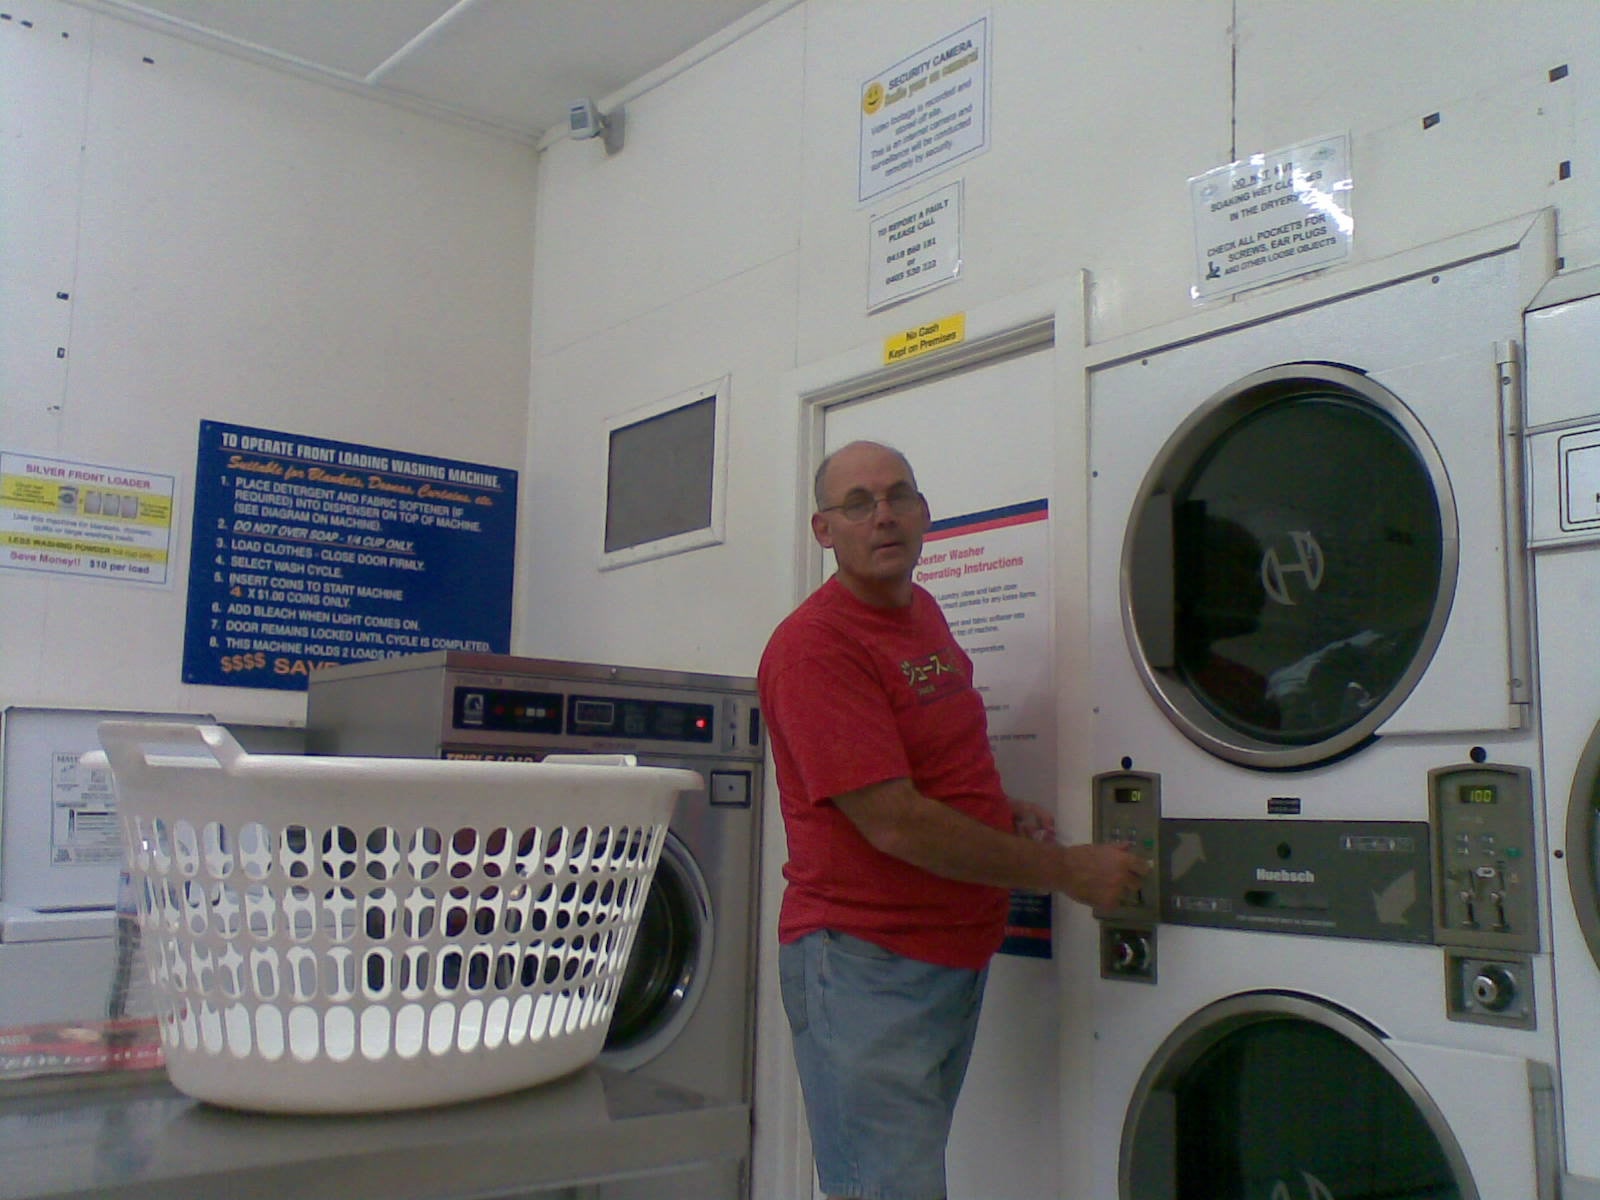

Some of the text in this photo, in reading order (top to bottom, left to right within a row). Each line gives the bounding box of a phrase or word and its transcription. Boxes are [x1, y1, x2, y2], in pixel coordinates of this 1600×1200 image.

[888, 59, 931, 90] SECURITY
[932, 39, 972, 66] CAMERA
[1210, 192, 1250, 212] SOAKING
[1253, 184, 1273, 199] WET
[888, 213, 917, 232] REPORT
[925, 199, 949, 216] FAULT
[1230, 212, 1239, 222] IN
[1241, 205, 1259, 218] THE
[889, 217, 936, 243] PLEASE CALL
[1207, 213, 1326, 258] CHECK ALL POCKETS FOR
[1270, 226, 1327, 249] EAR PLUGS
[1224, 237, 1337, 276] AND OTHER LOOSE OBJECTS
[906, 323, 939, 341] No Cash
[888, 331, 957, 361] Kept on Premises
[222, 432, 500, 488] TO OPERATE FRONT LOADING WASHING MACHINE.
[284, 466, 305, 480] for
[26, 464, 151, 489] SILVER FRONT LOADER
[235, 489, 293, 508] REQUIRED)
[296, 498, 320, 511] INTO
[323, 501, 380, 518] DISPENSER
[382, 509, 397, 521] ON
[400, 510, 419, 523] TOP
[421, 514, 434, 526] OF
[236, 477, 270, 491] PLACE
[273, 482, 336, 499] DETERGENT
[337, 491, 358, 504] AND
[361, 495, 396, 509] FABRIC
[400, 500, 450, 516] SOFTENER
[234, 502, 259, 515] (SEE
[261, 505, 310, 521] DIAGRAM
[312, 513, 328, 525] ON
[8, 536, 110, 553] LESS WASHING POWDER
[234, 520, 252, 532] DO
[254, 522, 278, 535] NOT
[278, 525, 309, 538] OVER
[309, 529, 340, 542] SOAP
[363, 536, 385, 548] CUP
[10, 551, 150, 575] Save Money!! $10 per load
[231, 539, 260, 553] LOAD
[264, 542, 313, 558] CLOTHES
[321, 550, 355, 564] CLOSE
[358, 553, 387, 566] DOOR
[231, 556, 272, 570] SELECT
[274, 561, 305, 574] WASH
[950, 546, 985, 561] Washer
[916, 555, 1023, 583] Operating Instructions
[229, 573, 268, 587] INSERT
[270, 577, 304, 590] COINS
[307, 580, 321, 592] TO
[323, 583, 355, 597] START
[357, 585, 404, 601] MACHINE
[247, 588, 255, 599] X
[257, 589, 285, 602] $1.00
[287, 592, 320, 605] COINS
[227, 603, 251, 615] ADD
[254, 605, 296, 619] BLEACH
[299, 609, 330, 622] WHEN
[332, 612, 362, 625] LIGHT
[364, 616, 401, 629] COMES
[226, 620, 258, 633] DOOR
[261, 623, 308, 638] REMAINS
[311, 628, 353, 642] LOCKED
[355, 631, 384, 645] UNTIL
[386, 634, 418, 647] CYCLE
[420, 637, 430, 648] IS
[226, 638, 250, 650] THIS
[253, 639, 302, 654] MACHINE
[304, 644, 340, 657] HOLDS
[342, 647, 349, 657] 2
[351, 648, 385, 660] LOADS
[1470, 789, 1493, 803] 100
[1256, 868, 1315, 883] Huebsch
